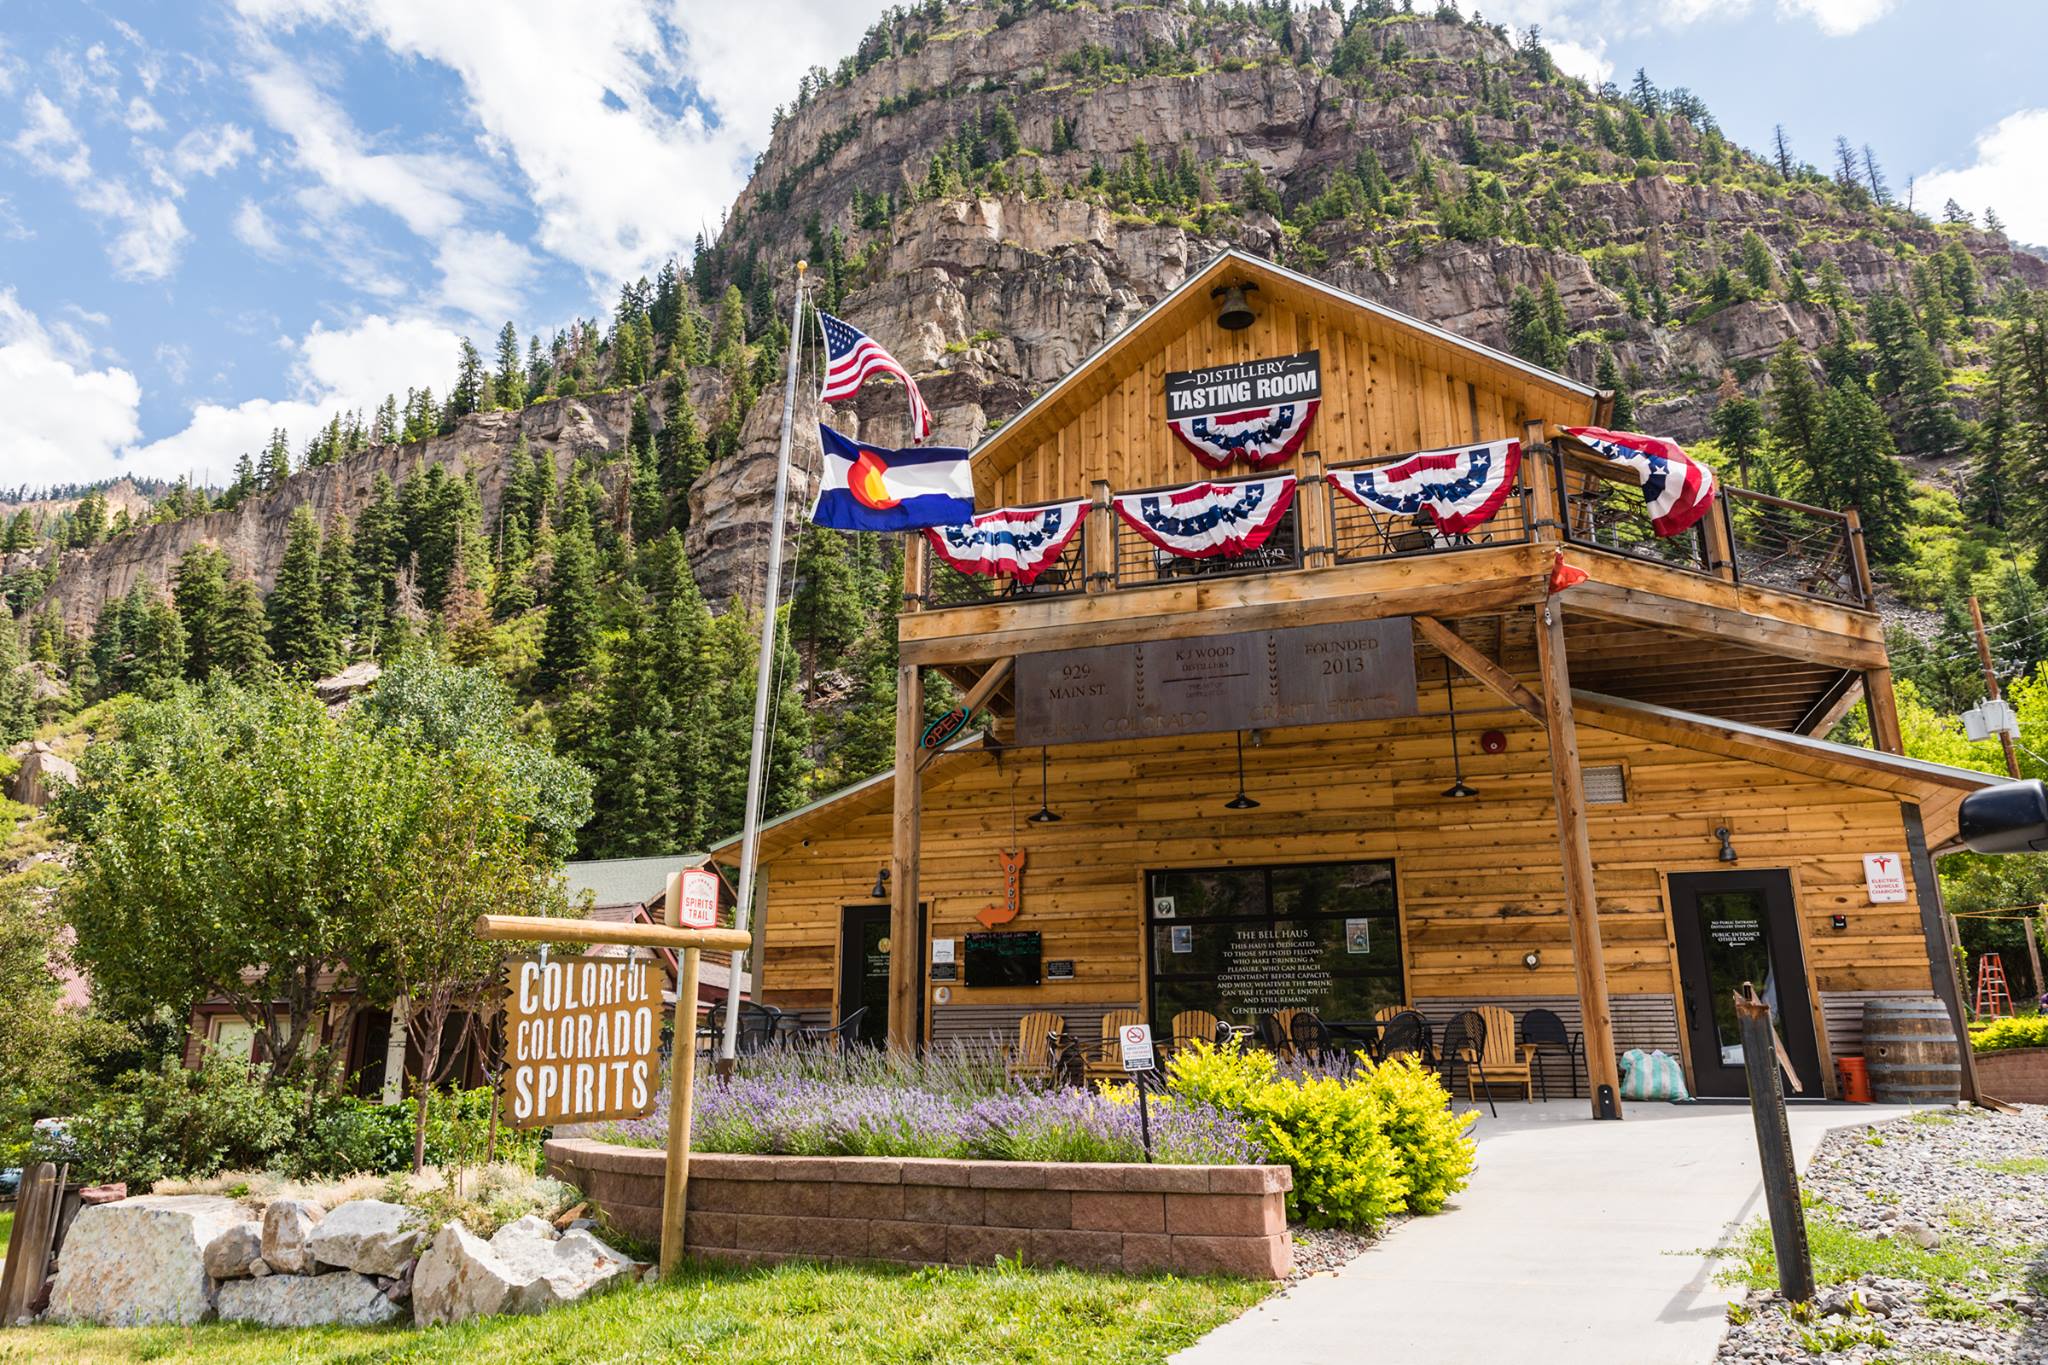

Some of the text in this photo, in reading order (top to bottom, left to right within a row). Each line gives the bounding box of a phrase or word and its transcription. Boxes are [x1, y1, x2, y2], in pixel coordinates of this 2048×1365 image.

[1196, 360, 1287, 386] DISTILLERY
[1170, 370, 1317, 411] TASTING ROOM
[1195, 646, 1236, 658] WOOD
[1304, 639, 1379, 656] FOUNDED
[1062, 664, 1091, 680] 929
[1322, 657, 1365, 675] 2013
[1049, 685, 1109, 700] MAIN ST.
[925, 709, 964, 748] OPEN
[1103, 711, 1208, 734] COLORADO
[1007, 863, 1016, 911] OPEN
[685, 897, 713, 910] SPIRITS
[688, 908, 709, 921] TRAIL
[1237, 929, 1309, 940] THE BELL HAUS
[1276, 940, 1315, 948] DEDICATED
[1217, 973, 1269, 981] CONTENTMENT
[518, 961, 649, 1015] COLORFUL
[1231, 1006, 1280, 1015] GENTLEMEN
[516, 1006, 653, 1062] COLORADO
[514, 1060, 648, 1120] SPIRITS
